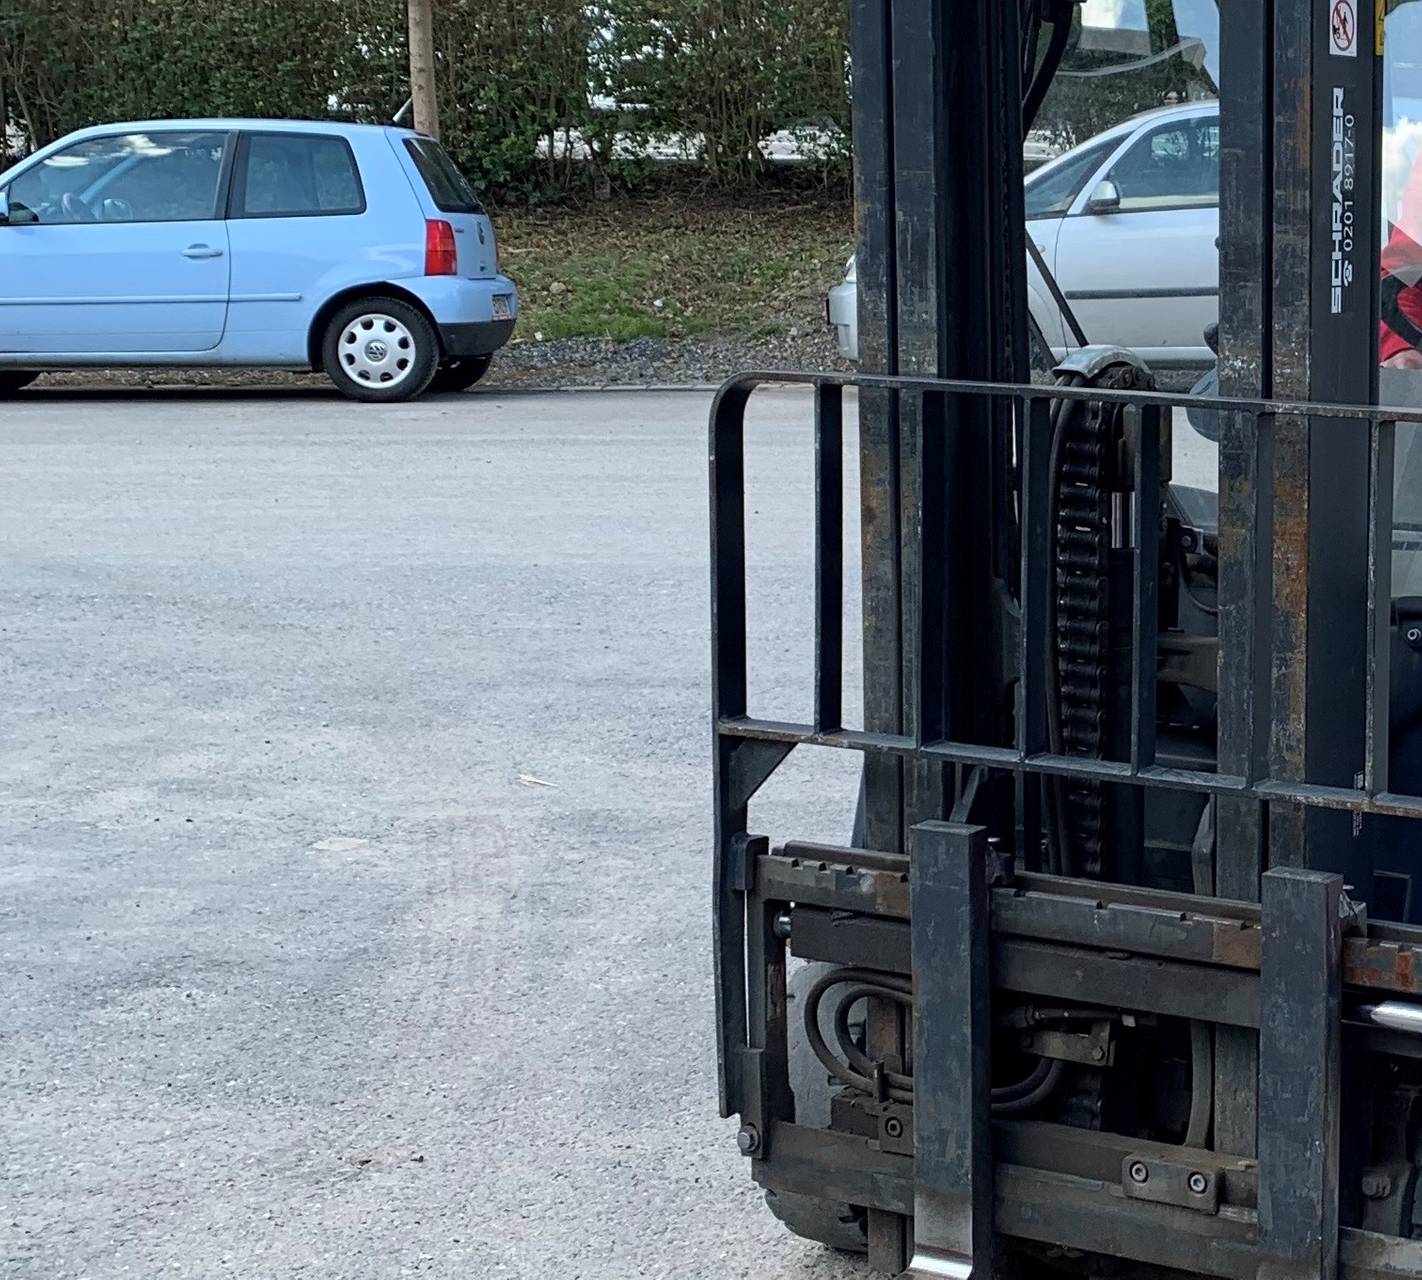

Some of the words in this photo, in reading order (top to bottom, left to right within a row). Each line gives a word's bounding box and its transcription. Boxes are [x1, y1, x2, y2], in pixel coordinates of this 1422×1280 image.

[1344, 114, 1355, 191] 8917-0
[1331, 87, 1344, 314] SCHRADER
[1343, 201, 1354, 251] 0201
